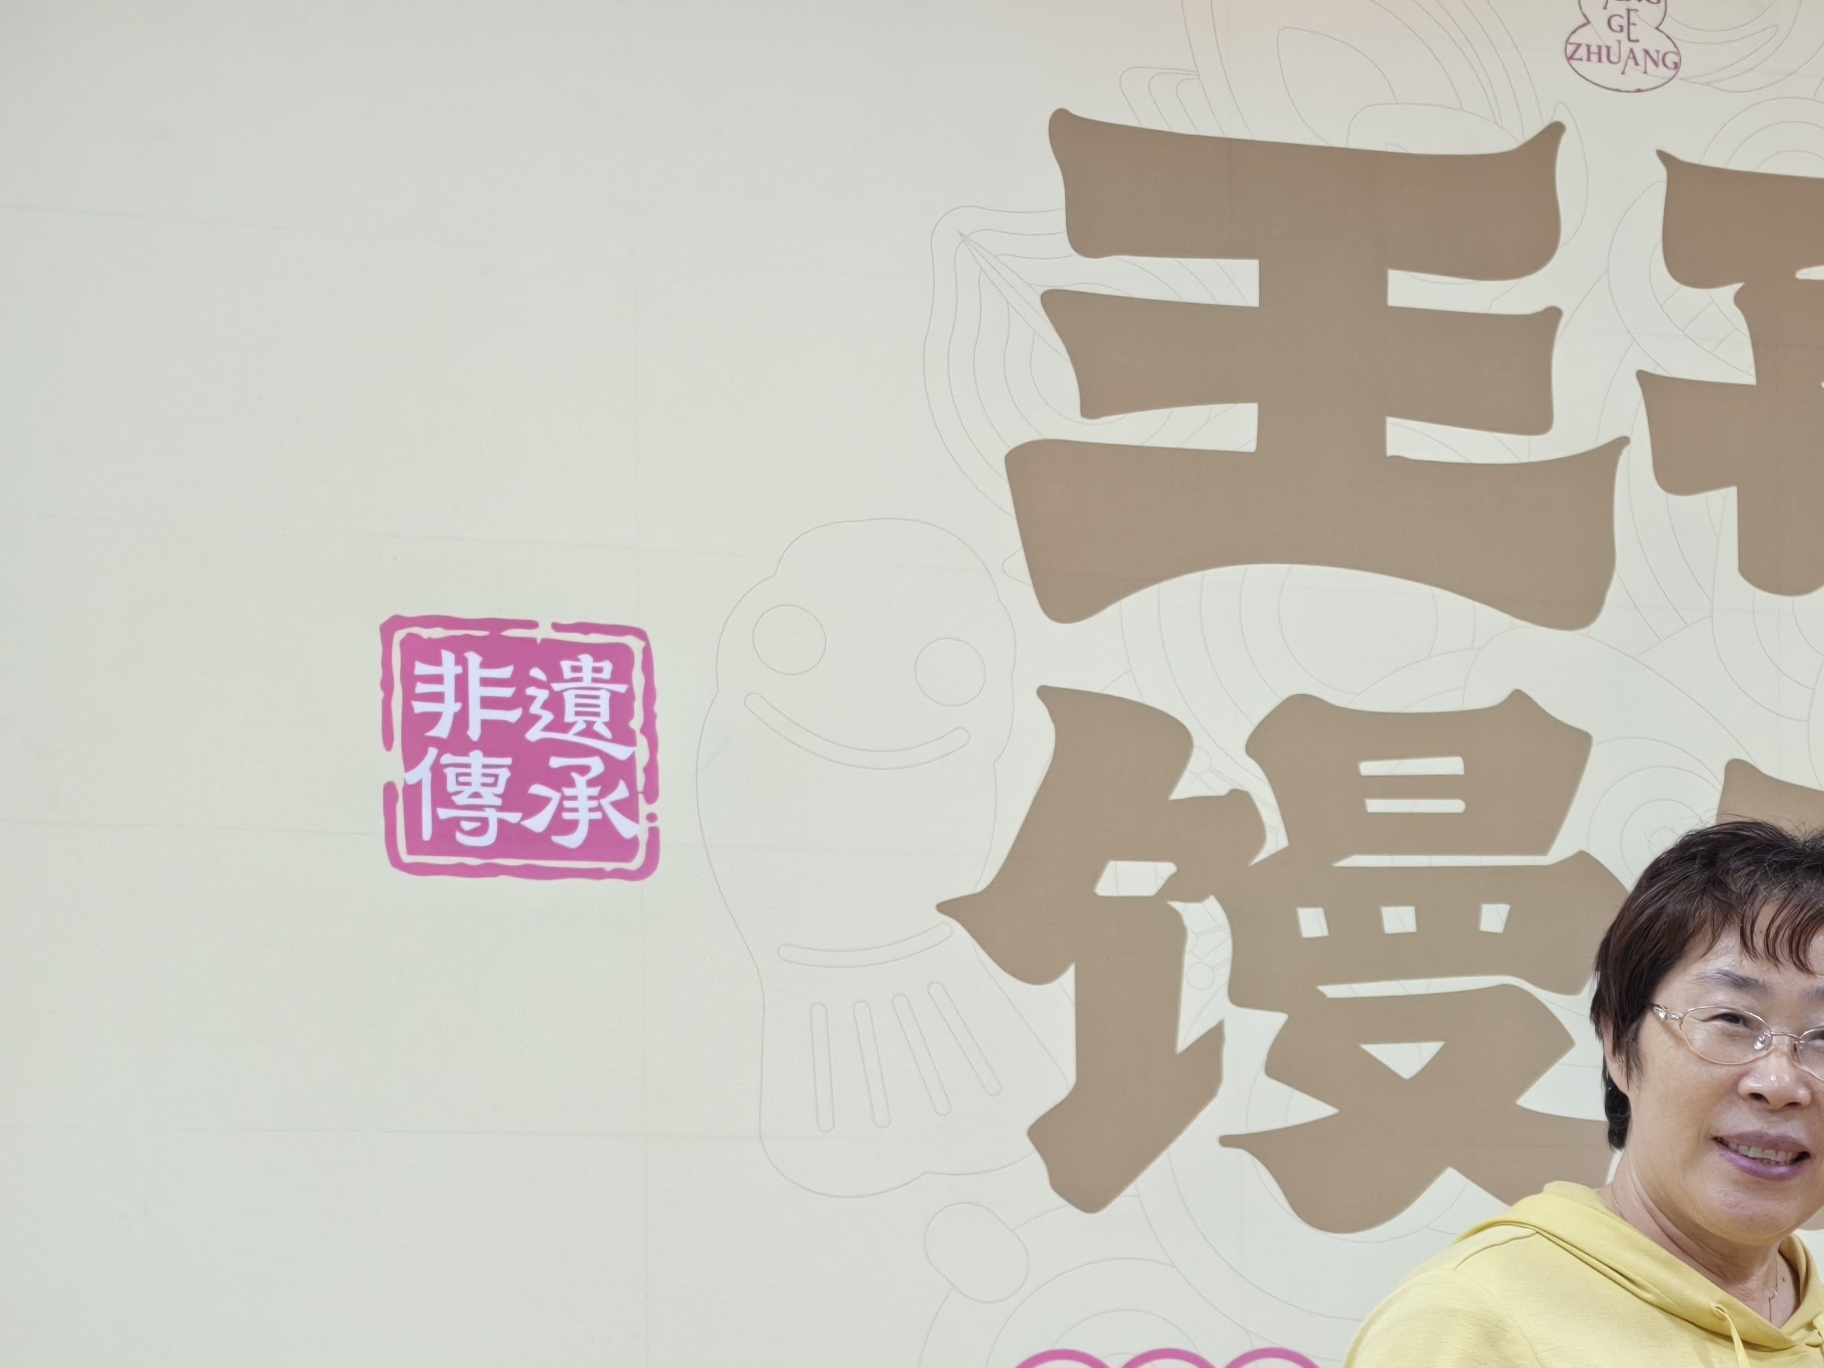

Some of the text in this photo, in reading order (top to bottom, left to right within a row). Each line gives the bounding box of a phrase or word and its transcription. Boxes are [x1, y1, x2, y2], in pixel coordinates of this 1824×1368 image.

[1567, 40, 1681, 75] ZHUANG
[1607, 8, 1640, 43] GE
[411, 649, 638, 762] 非遺
[404, 747, 641, 849] 傳承
